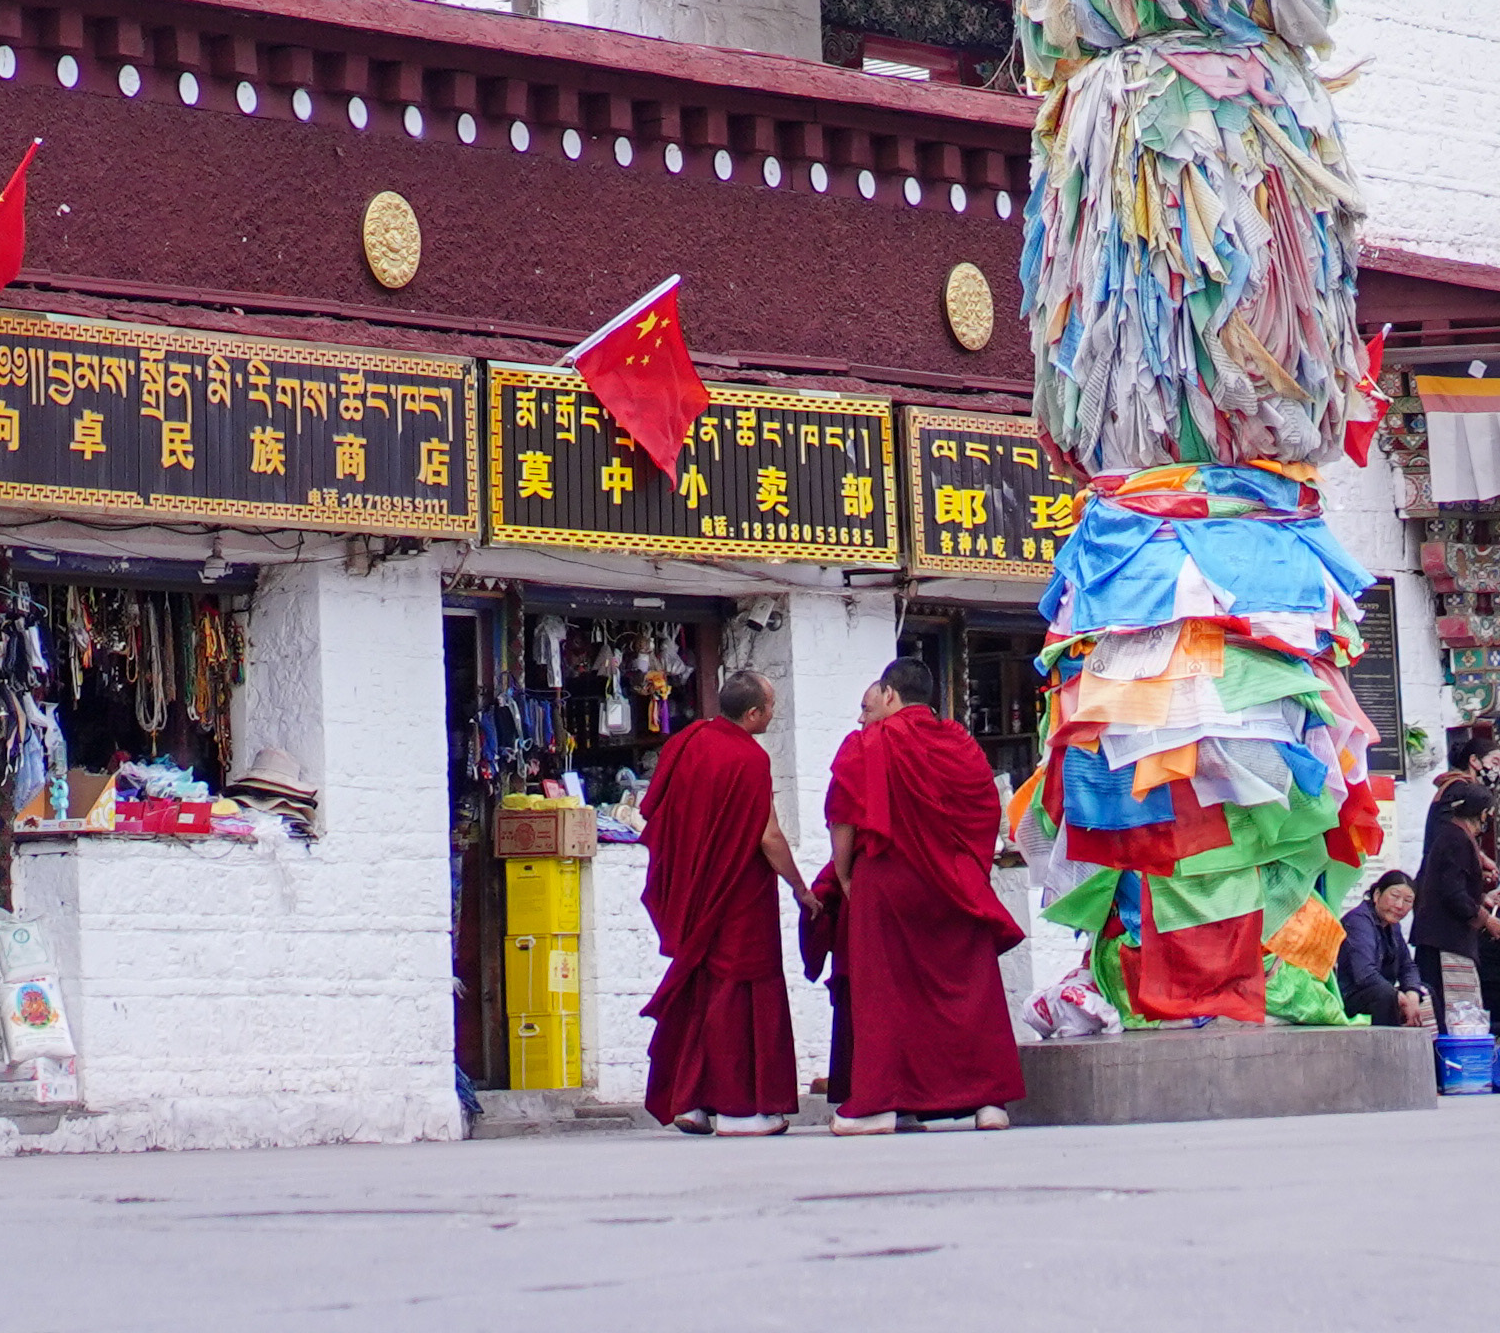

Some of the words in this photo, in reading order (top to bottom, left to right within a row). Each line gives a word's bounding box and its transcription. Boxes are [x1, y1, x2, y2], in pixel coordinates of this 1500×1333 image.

[517, 450, 875, 519] 莫中小卖部
[934, 484, 1078, 537] 郎珍
[741, 520, 875, 547] 18308053685
[940, 530, 1007, 559] 各种小吃
